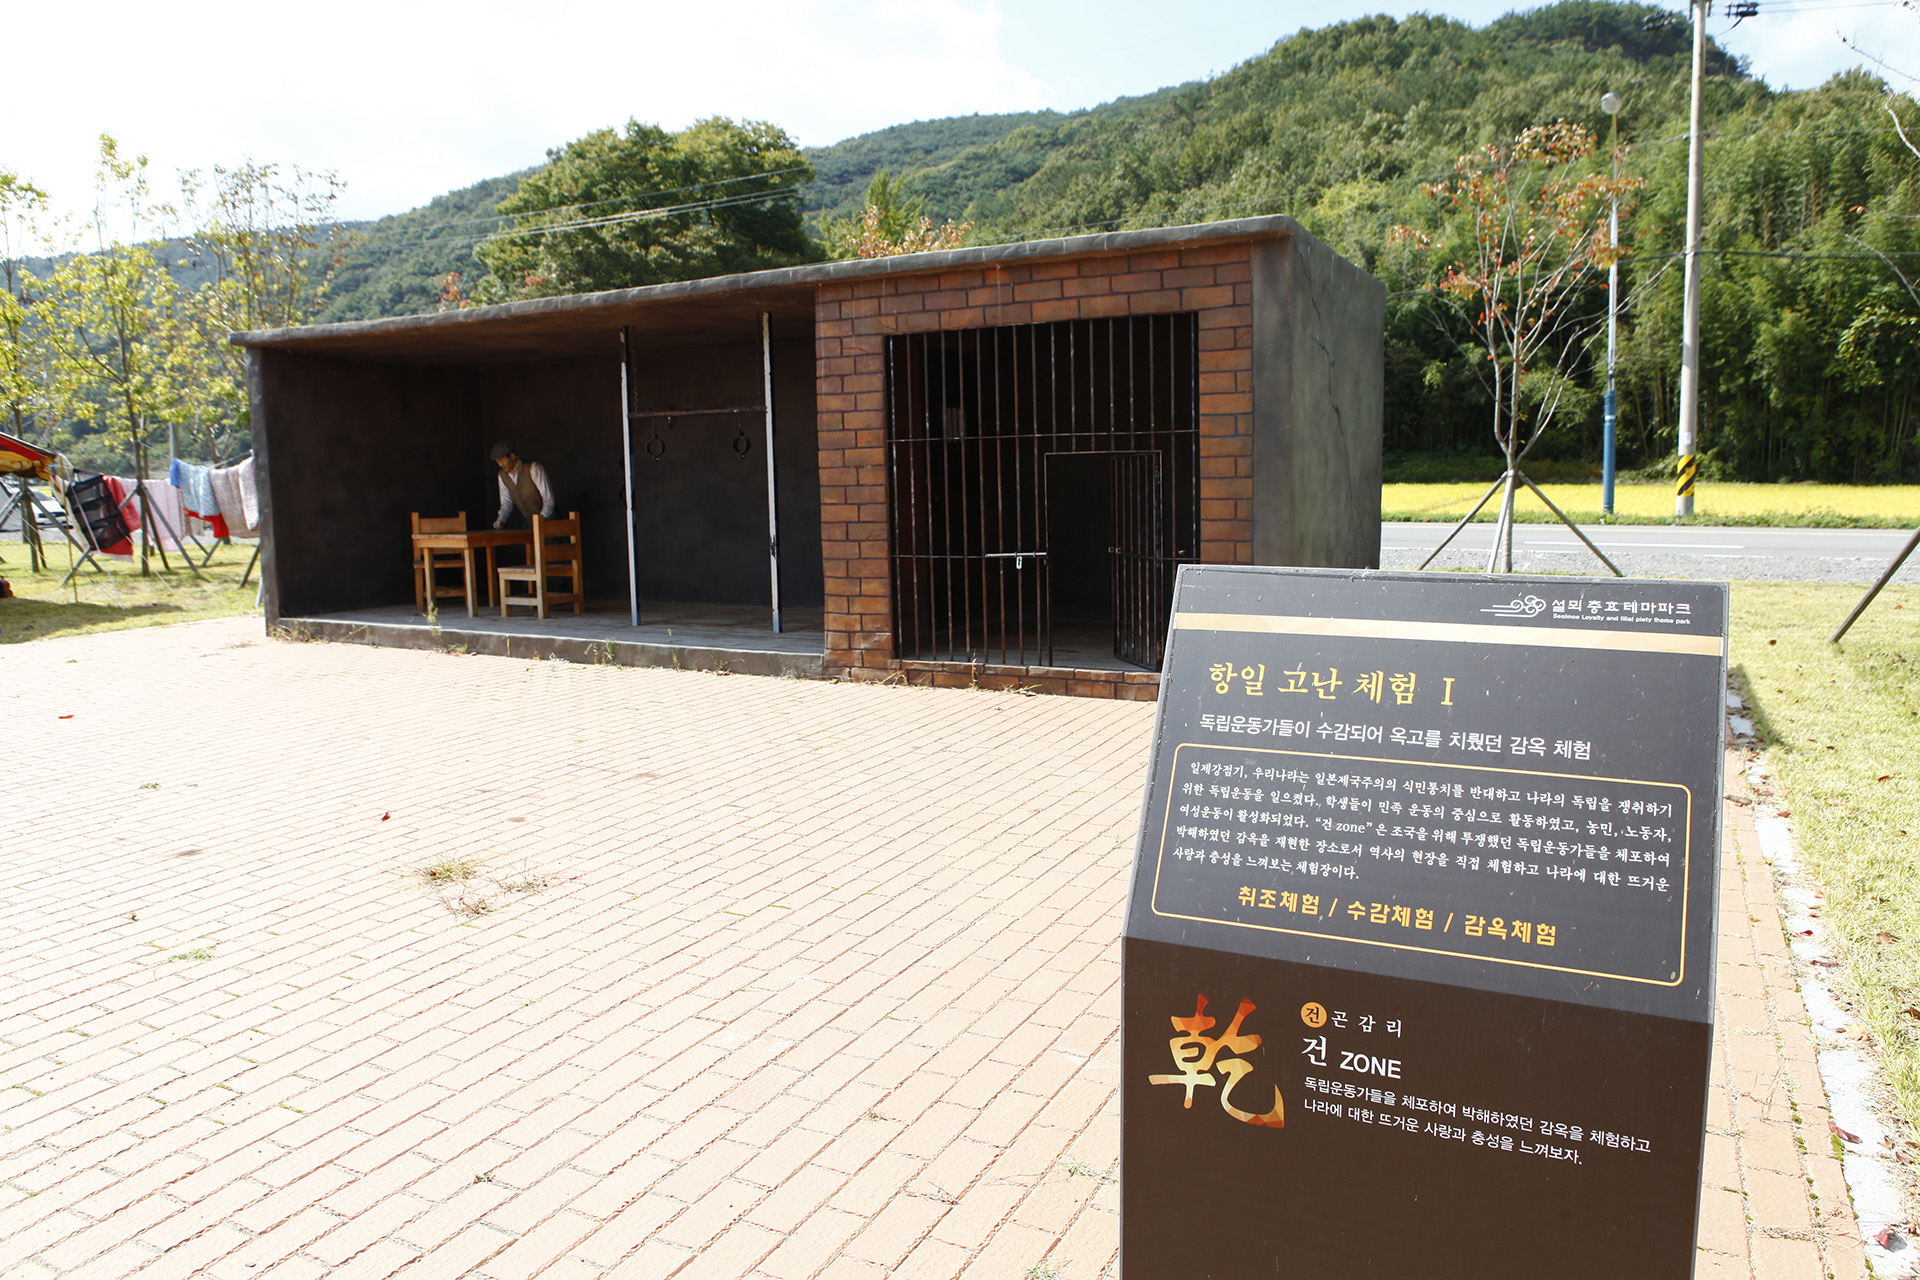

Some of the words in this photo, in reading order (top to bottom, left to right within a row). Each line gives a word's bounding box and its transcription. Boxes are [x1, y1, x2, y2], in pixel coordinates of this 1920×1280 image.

[1208, 662, 1266, 696] 항일
[1277, 666, 1342, 699] 고난
[1353, 670, 1416, 705] 체험
[1199, 713, 1310, 737] 독립운동가들이
[1315, 721, 1382, 743] 수감되어
[1389, 726, 1442, 748] 옥고를
[1509, 736, 1546, 756] 감옥
[1552, 739, 1590, 760] 체험
[1182, 782, 1204, 795] 위한
[1208, 784, 1264, 801] 독립운동을
[1270, 790, 1318, 806] 일으켰다.
[1325, 795, 1371, 812] 학생들이
[1378, 800, 1402, 815] 민족
[1407, 803, 1444, 819] 운동의
[1451, 807, 1502, 823] 중심으로
[1508, 812, 1579, 833] 활동하였고,
[1585, 820, 1617, 837] 농민,
[1624, 825, 1671, 843] 노동자,
[1190, 761, 1247, 778] 일제강점기,
[1252, 766, 1310, 784] 우리나라는
[1315, 771, 1396, 791] 일본제국주의의
[1402, 779, 1464, 798] 식민통치를
[1469, 785, 1520, 801] 반대하고
[1526, 790, 1564, 807] 나라의
[1571, 794, 1612, 812] 독립을
[1617, 799, 1671, 818] 쟁취하기
[1172, 846, 1205, 864] 사랑과
[1208, 850, 1242, 866] 충성을
[1245, 855, 1292, 871] 느껴보는
[1295, 860, 1359, 879] 체험장이다.
[1176, 824, 1230, 842] 박해하였던
[1235, 831, 1270, 847] 감옥을
[1274, 835, 1310, 851] 재현한
[1315, 839, 1362, 857] 장소로서
[1369, 845, 1404, 862] 역사의
[1411, 849, 1449, 867] 현장을
[1455, 854, 1480, 870] 직접
[1486, 858, 1539, 875] 체험하고
[1545, 864, 1586, 882] 나라에
[1593, 870, 1621, 886] 대한
[1626, 875, 1670, 892] 뜨거운
[1179, 803, 1233, 820] 여성운동이
[1236, 809, 1308, 828] 활성화되었다.
[1375, 822, 1387, 836] 은
[1390, 825, 1428, 841] 조국을
[1431, 828, 1456, 844] 위해
[1460, 831, 1511, 849] 투쟁했던
[1516, 838, 1612, 857] 독립운동가들을
[1614, 847, 1669, 867] 체포하여
[1237, 886, 1321, 916] 취조체험
[1327, 897, 1338, 917] /
[1347, 900, 1434, 930] 수감체험
[1443, 912, 1453, 932] /
[1464, 914, 1556, 946] 감옥체험
[1148, 993, 1285, 1129] 乾
[1301, 1035, 1328, 1067] 건
[1339, 1050, 1401, 1079] ZONE
[1304, 1076, 1396, 1106] 독립운동가들을
[1401, 1094, 1456, 1117] 체포하여
[1462, 1105, 1532, 1132] 박해하였던
[1539, 1120, 1584, 1141] 감옥을
[1589, 1129, 1651, 1152] 체험하고
[1304, 1098, 1342, 1117] 나라에
[1347, 1107, 1374, 1123] 대한
[1378, 1113, 1419, 1132] 뜨거운
[1423, 1121, 1466, 1142] 사랑과
[1470, 1129, 1514, 1151] 충성을
[1518, 1139, 1582, 1164] 느껴보자.
